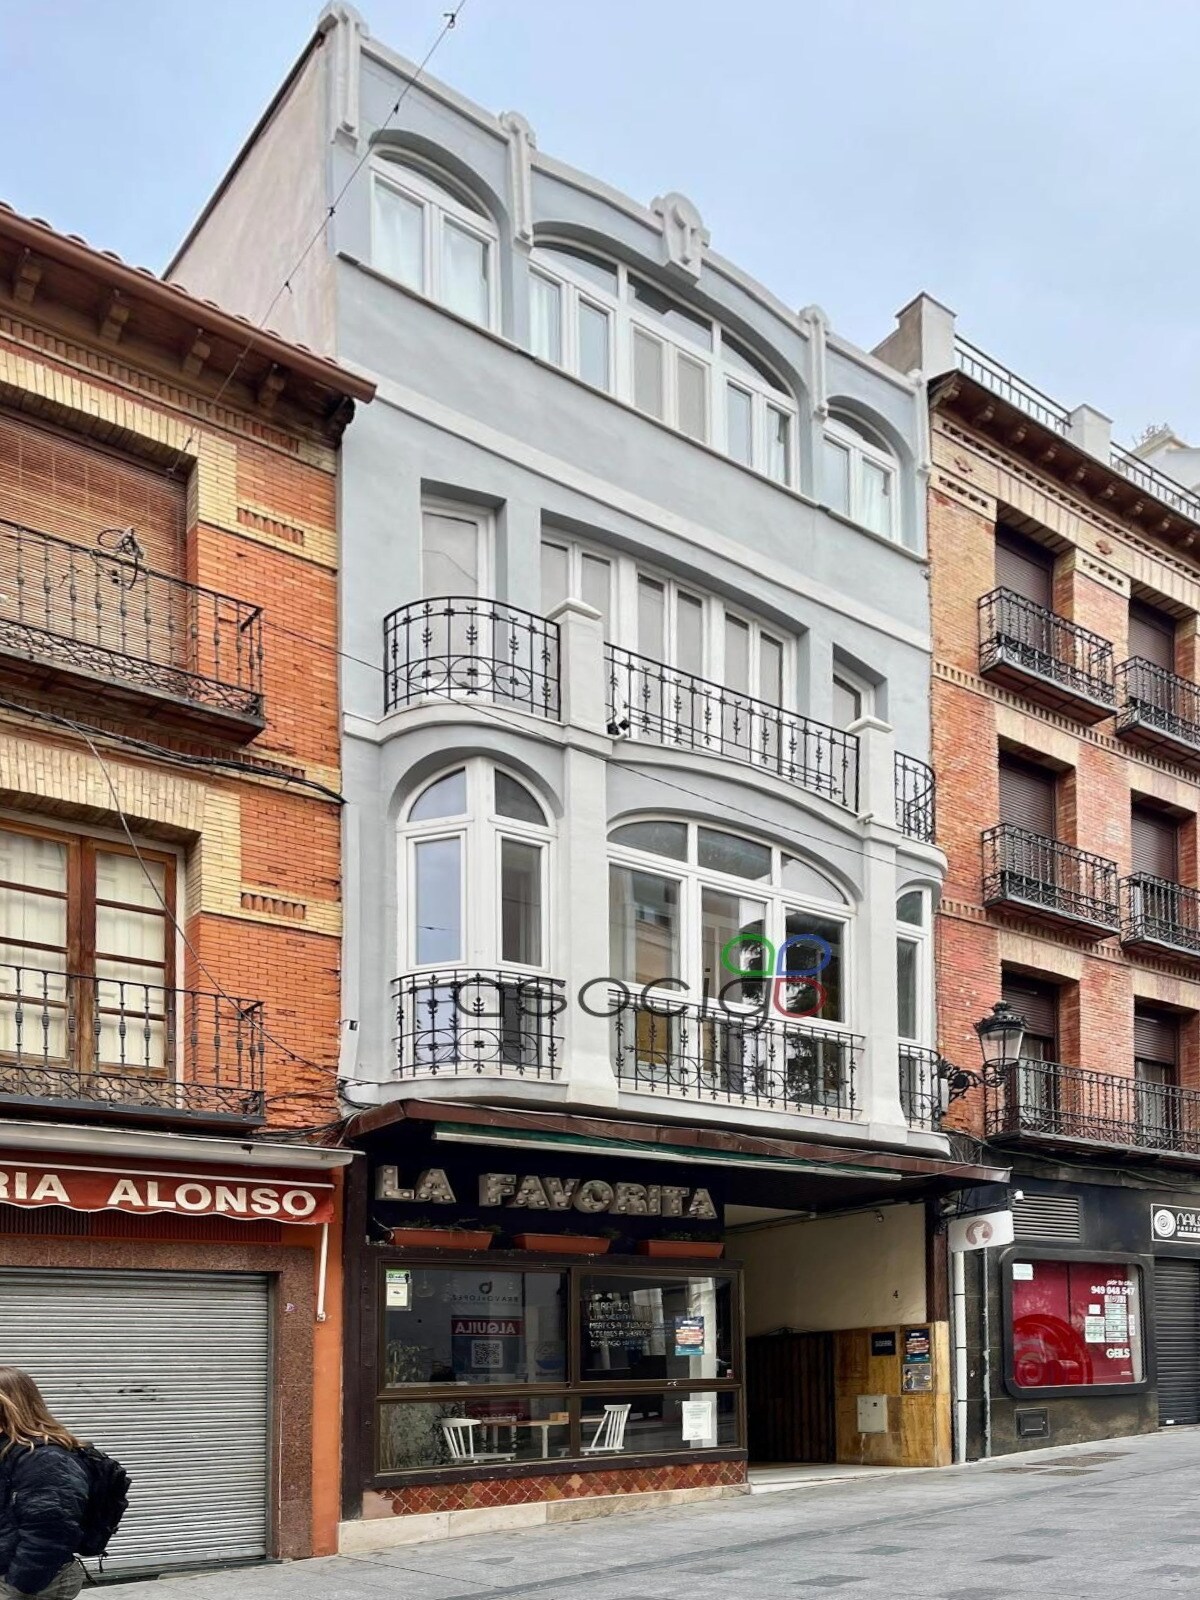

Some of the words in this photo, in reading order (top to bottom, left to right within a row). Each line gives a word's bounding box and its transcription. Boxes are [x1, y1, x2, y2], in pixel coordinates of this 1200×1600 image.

[107, 1179, 318, 1217] ALONSO
[375, 1164, 457, 1205] LA
[478, 1172, 718, 1220] FAVORITA
[893, 1290, 899, 1299] 4
[1091, 1286, 1105, 1294] 949
[1121, 1287, 1135, 1296] 547
